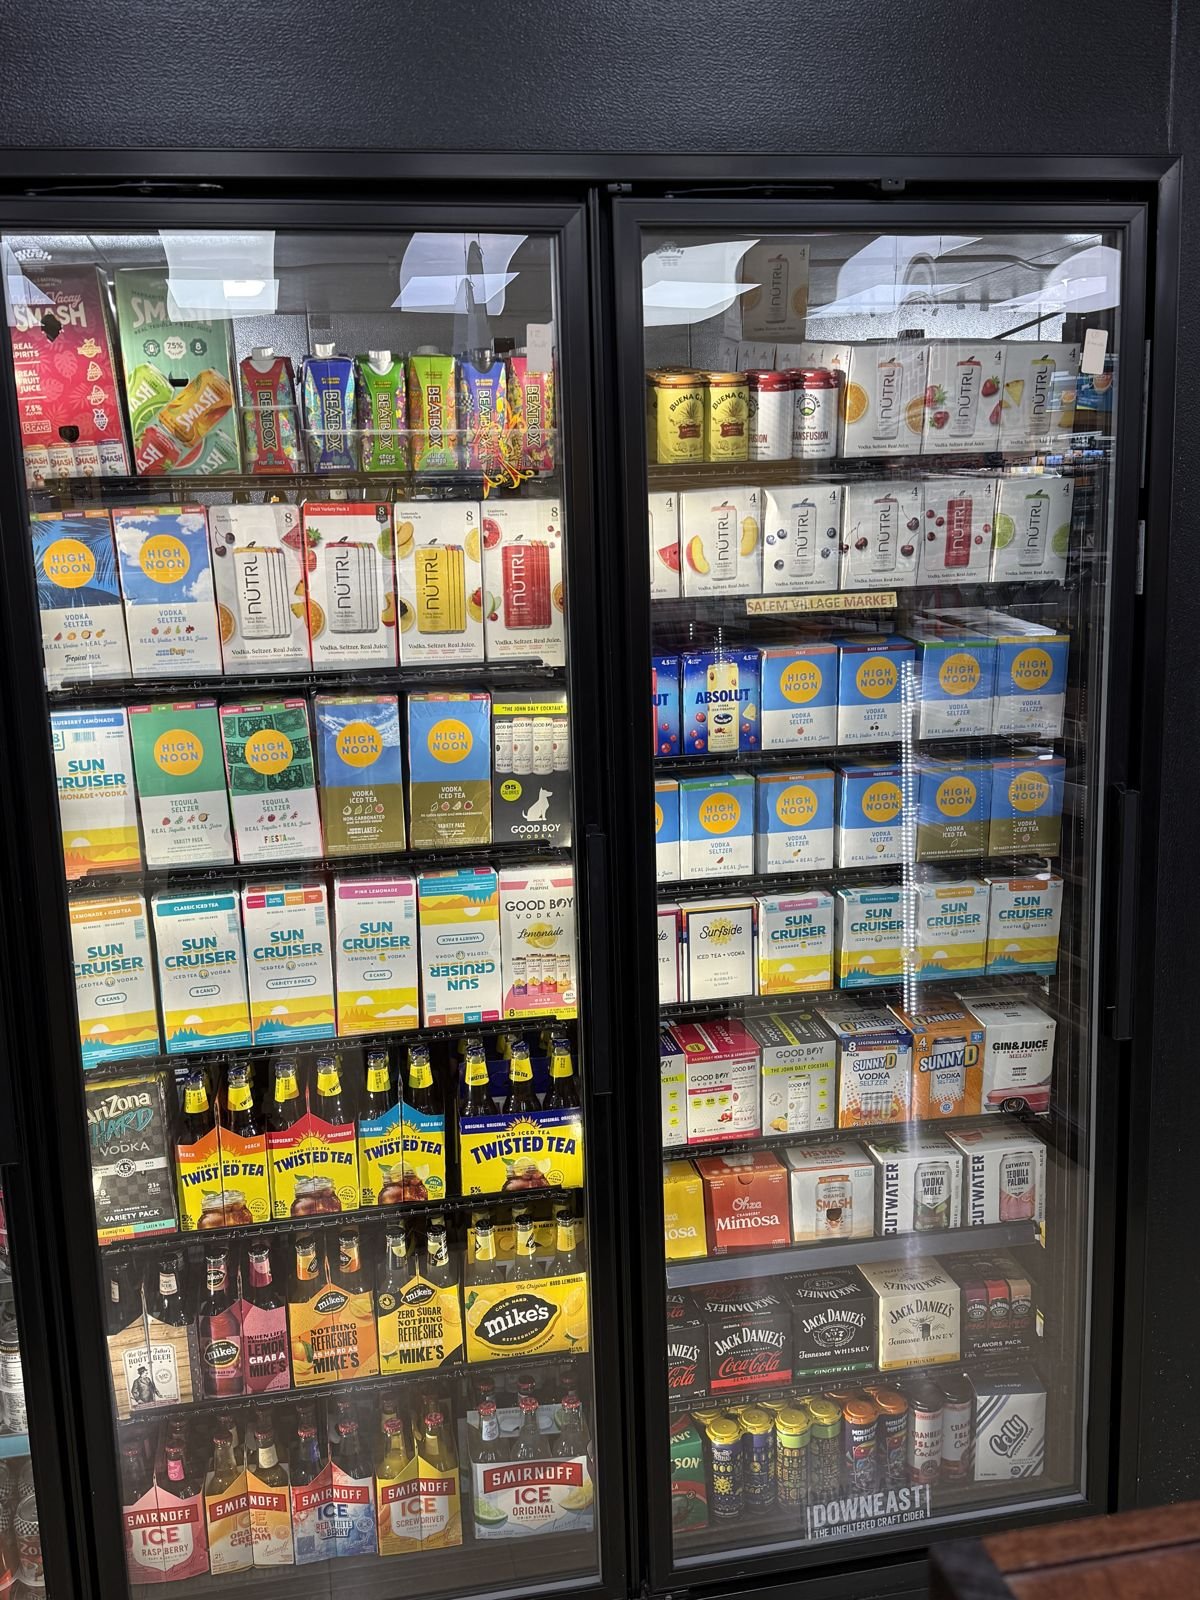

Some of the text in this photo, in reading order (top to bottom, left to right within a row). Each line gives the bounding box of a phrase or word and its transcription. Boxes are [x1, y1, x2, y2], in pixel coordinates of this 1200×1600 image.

[20, 383, 41, 393] JUICE
[712, 392, 737, 410] BUENA
[176, 386, 220, 432] SMASH
[525, 384, 541, 447] BEATBOX
[257, 390, 278, 450] BEATBOX
[323, 390, 344, 452] BEATBOX
[377, 392, 393, 450] BEATBOX
[427, 385, 444, 449] BEATBOX
[750, 493, 756, 503] 4
[379, 507, 384, 515] 8
[52, 553, 86, 563] HIGH
[147, 548, 181, 558] HIGH
[50, 564, 91, 574] NOON
[146, 560, 185, 569] NOON
[747, 594, 894, 612] SALEM VILLAGE MARKET
[64, 620, 93, 628] SELTZER
[788, 673, 815, 681] HIGH
[863, 669, 891, 677] HIGH
[784, 682, 818, 691] NOON
[695, 689, 750, 704] ABSOLUT
[344, 735, 375, 744] HIGH
[436, 732, 465, 741] HIGH
[162, 742, 194, 752] HIGH
[253, 742, 284, 751] HIGH
[342, 745, 378, 754] NOON
[432, 741, 468, 750] NOON
[160, 752, 199, 762] NOON
[251, 752, 288, 762] NOON
[68, 759, 105, 773] SUN
[783, 797, 811, 806] HIGH
[781, 806, 813, 815] NOON
[704, 814, 736, 822] NOON
[511, 824, 561, 833] GOOD BOY
[174, 903, 195, 911] CLASSIC
[505, 898, 573, 911] GOOD BOY
[1014, 897, 1040, 906] SUN
[785, 914, 812, 925] SUN
[865, 909, 892, 918] SUN
[999, 909, 1053, 919] CRUISER
[360, 922, 393, 934] SUN
[700, 925, 742, 939] Surfside
[771, 926, 826, 939] CRUISER
[851, 920, 904, 932] CRUISER
[270, 929, 304, 942] SUN
[517, 927, 563, 939] Lemonade
[181, 937, 217, 951] SUN
[342, 936, 410, 950] CRUISER
[87, 943, 124, 958] SUN
[253, 943, 323, 959] CRUISER
[165, 950, 237, 968] CRUISER
[430, 962, 496, 977] CRUISER
[447, 978, 479, 991] SUN
[992, 1040, 1048, 1051] GIN&JUICE
[776, 1047, 824, 1058] GOOD BOY
[920, 1045, 979, 1072] SUNNYD
[853, 1053, 896, 1072] SUNNYD
[691, 1073, 713, 1082] GOOD
[91, 1107, 153, 1145] HARD
[100, 1142, 150, 1156] VODKA
[364, 1140, 442, 1161] TWISTED TEA
[470, 1136, 576, 1164] TWISTED TEA
[274, 1151, 353, 1173] TWISTED TEA
[181, 1164, 264, 1186] TWISTED TEA
[1006, 1169, 1029, 1179] TEQUILA
[922, 1178, 944, 1187] VODKA
[924, 1187, 942, 1195] MULE
[972, 1155, 984, 1226] CUTWATER
[816, 1196, 853, 1211] SMASH
[884, 1163, 899, 1235] CUTWATER
[104, 1209, 160, 1222] VARIETY PACK
[716, 1214, 780, 1231] Mimosa
[318, 1296, 345, 1310] mike's
[397, 1307, 441, 1319] ZERO SUGAR
[889, 1299, 955, 1324] JACK DANIEL'S
[398, 1316, 442, 1327] NOTHING
[484, 1304, 549, 1337] mike's
[802, 1309, 866, 1333] JACK DANIEL'S
[310, 1323, 357, 1336] NOTHING
[399, 1324, 443, 1342] REFRESHES
[311, 1332, 357, 1350] REFRESHES
[714, 1328, 786, 1356] JACK DANIEL'S
[888, 1337, 921, 1346] Tennessee
[249, 1354, 273, 1364] GRAB
[400, 1346, 444, 1364] MIKE'S
[799, 1346, 870, 1359] Tennessee WHISKEY
[313, 1354, 359, 1374] MIKE'S
[989, 1414, 1028, 1458] Celly
[493, 1466, 573, 1485] SMIRNOFF
[388, 1482, 448, 1499] SMIRNOFF
[515, 1487, 551, 1504] ICE
[302, 1489, 362, 1506] SMIRNOFF
[216, 1495, 279, 1516] SMIRNOFF
[317, 1504, 348, 1520] ICE
[401, 1497, 437, 1515] ICE
[513, 1505, 555, 1516] ORIGINAL
[814, 1485, 923, 1526] DOWNEAST
[127, 1509, 191, 1526] SMIRNOFF
[396, 1515, 444, 1527] SCREWDRIVER
[814, 1510, 924, 1539] THE UNFILTERED CRAFT CIDER
[142, 1527, 180, 1546] ICE
